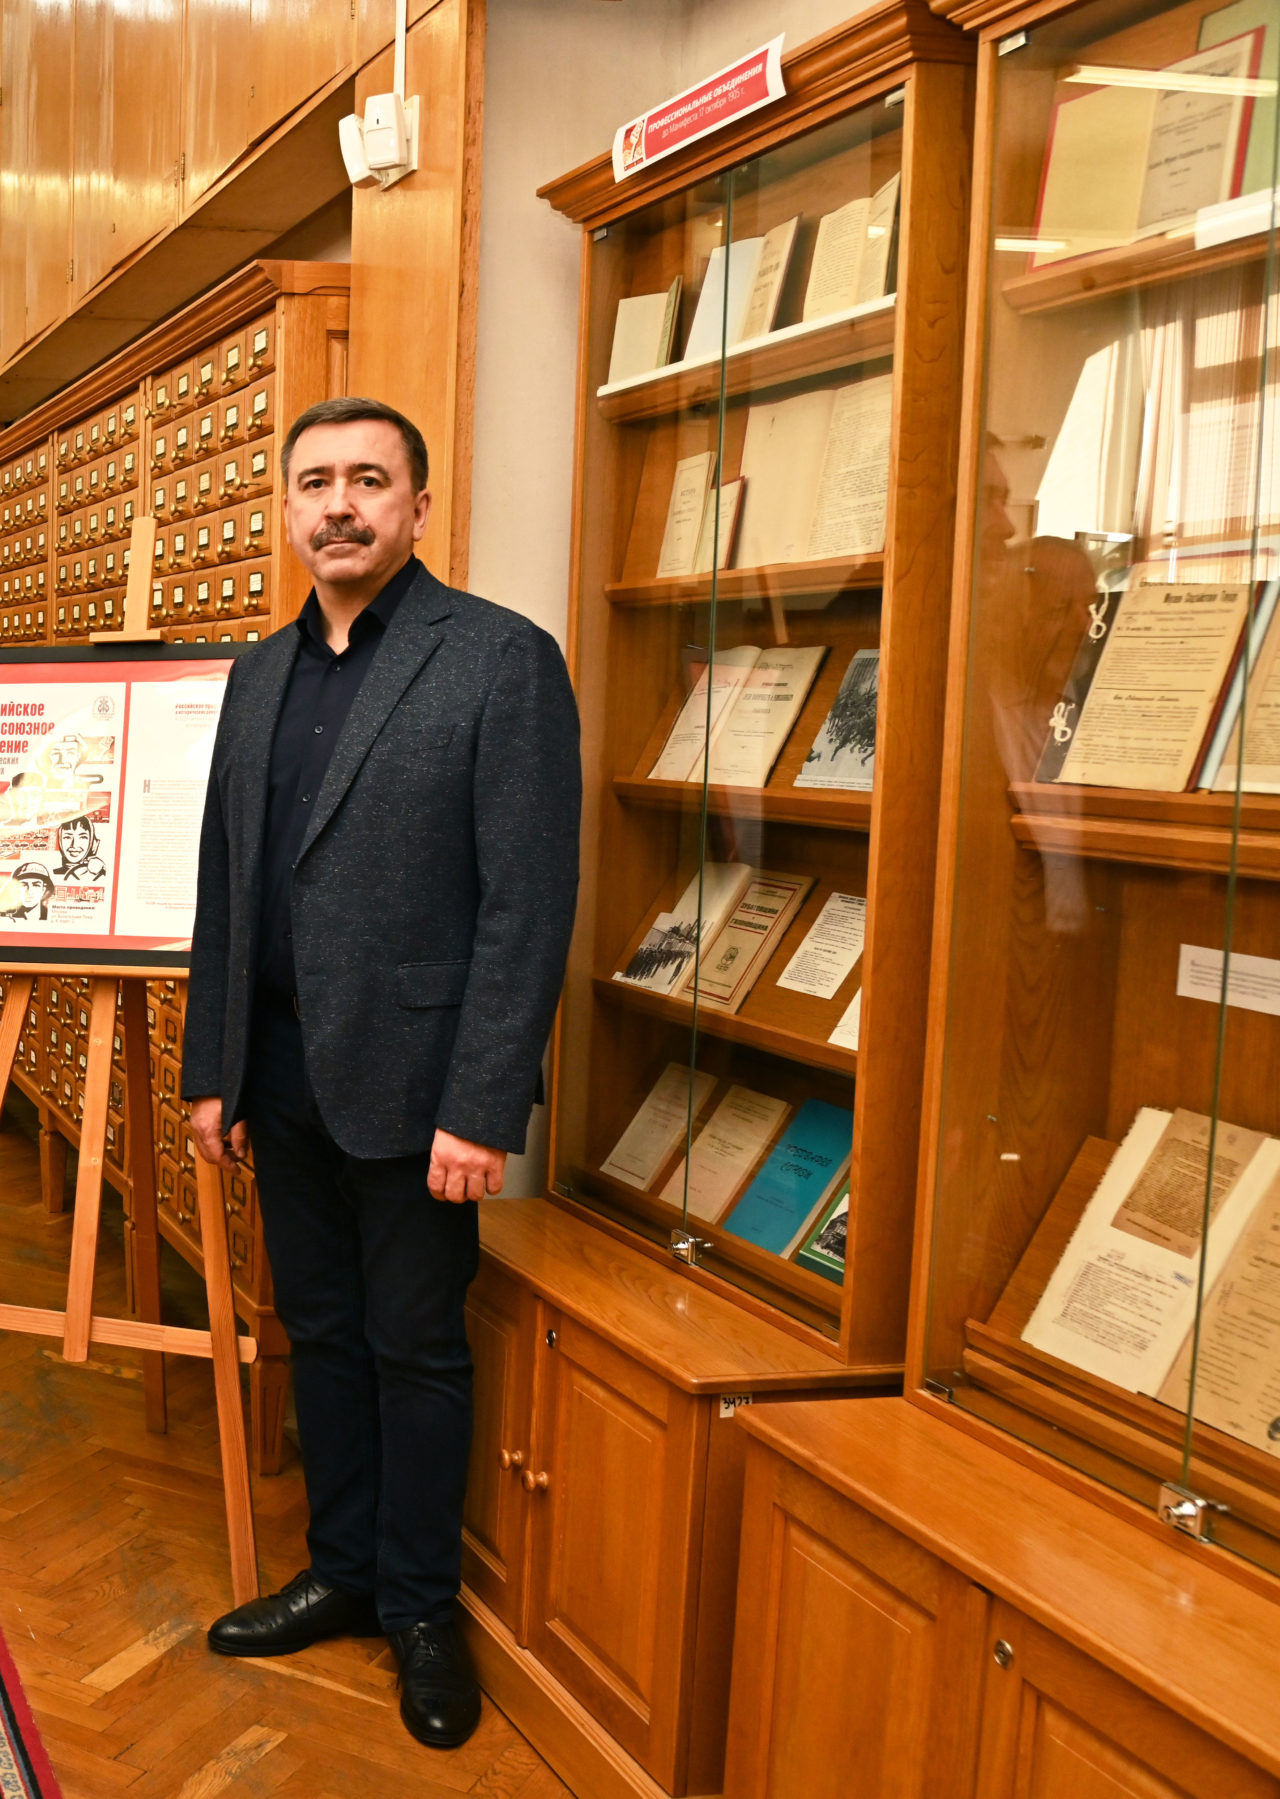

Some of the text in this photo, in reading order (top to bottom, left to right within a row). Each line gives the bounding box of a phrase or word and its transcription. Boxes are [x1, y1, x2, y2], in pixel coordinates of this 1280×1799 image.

[648, 64, 763, 133] ПРОФЕССИОНАЛЬНЫЕ ОБЪЕДИНЕНИЯ
[669, 114, 698, 132] Манифеста
[699, 107, 705, 117] 17
[705, 98, 726, 114] октября
[727, 91, 739, 102] 1905
